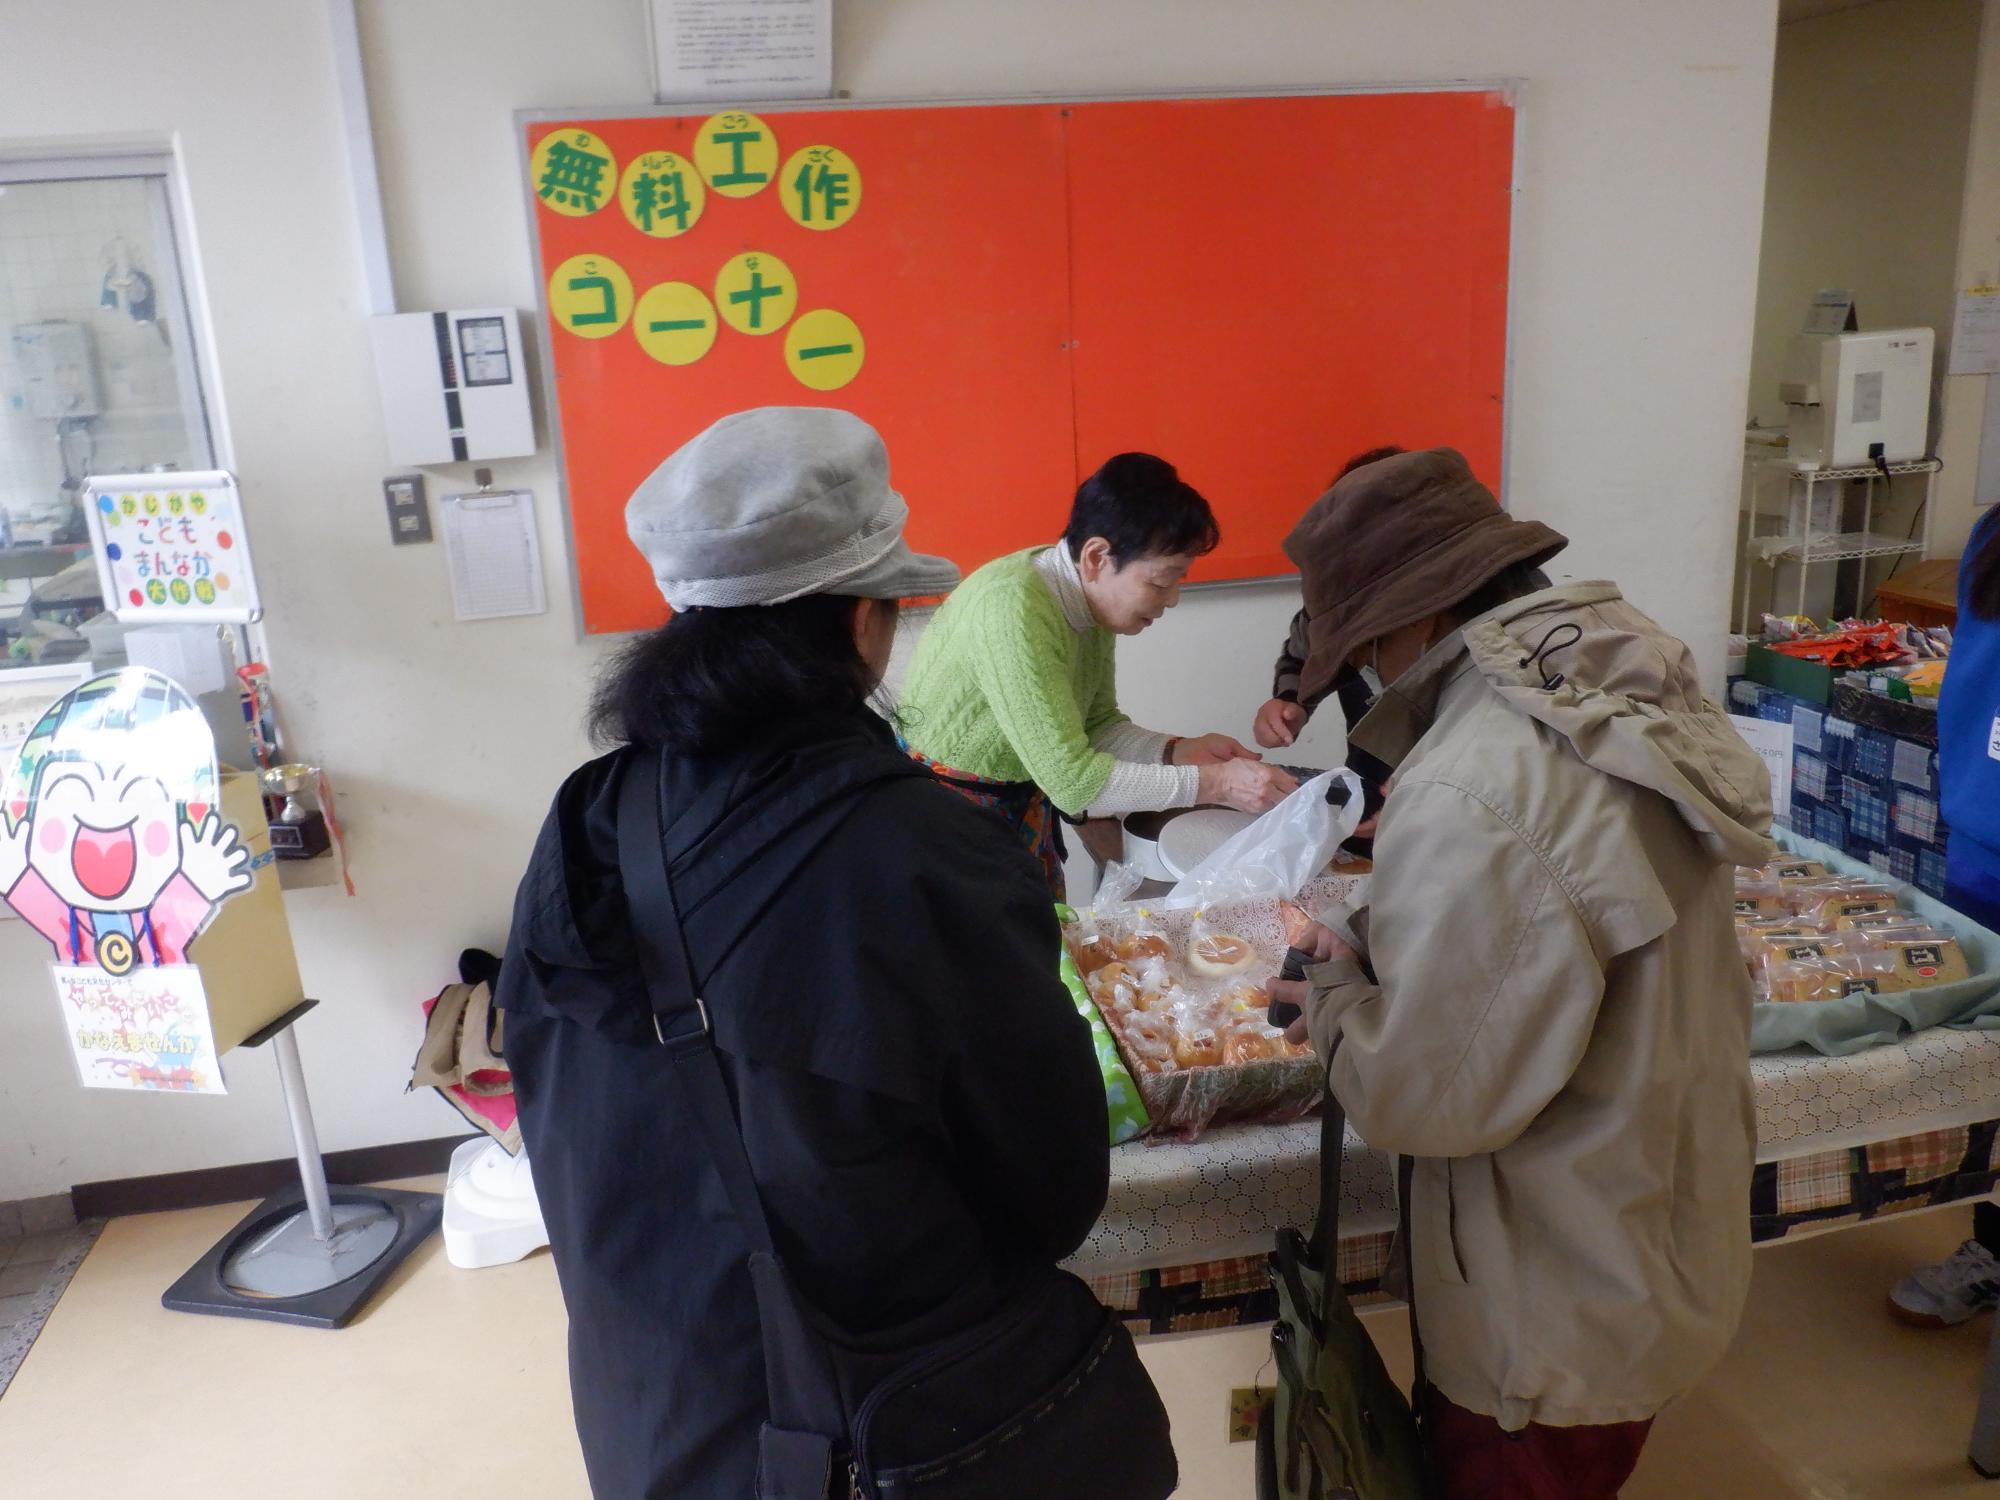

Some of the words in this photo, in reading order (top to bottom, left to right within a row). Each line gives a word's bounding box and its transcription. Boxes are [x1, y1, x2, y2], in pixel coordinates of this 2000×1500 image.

[807, 149, 835, 164] さく
[539, 131, 849, 232] 無料工作
[136, 516, 198, 545] こども
[133, 550, 213, 578] まんなか
[77, 1029, 194, 1054] かなえませんか
